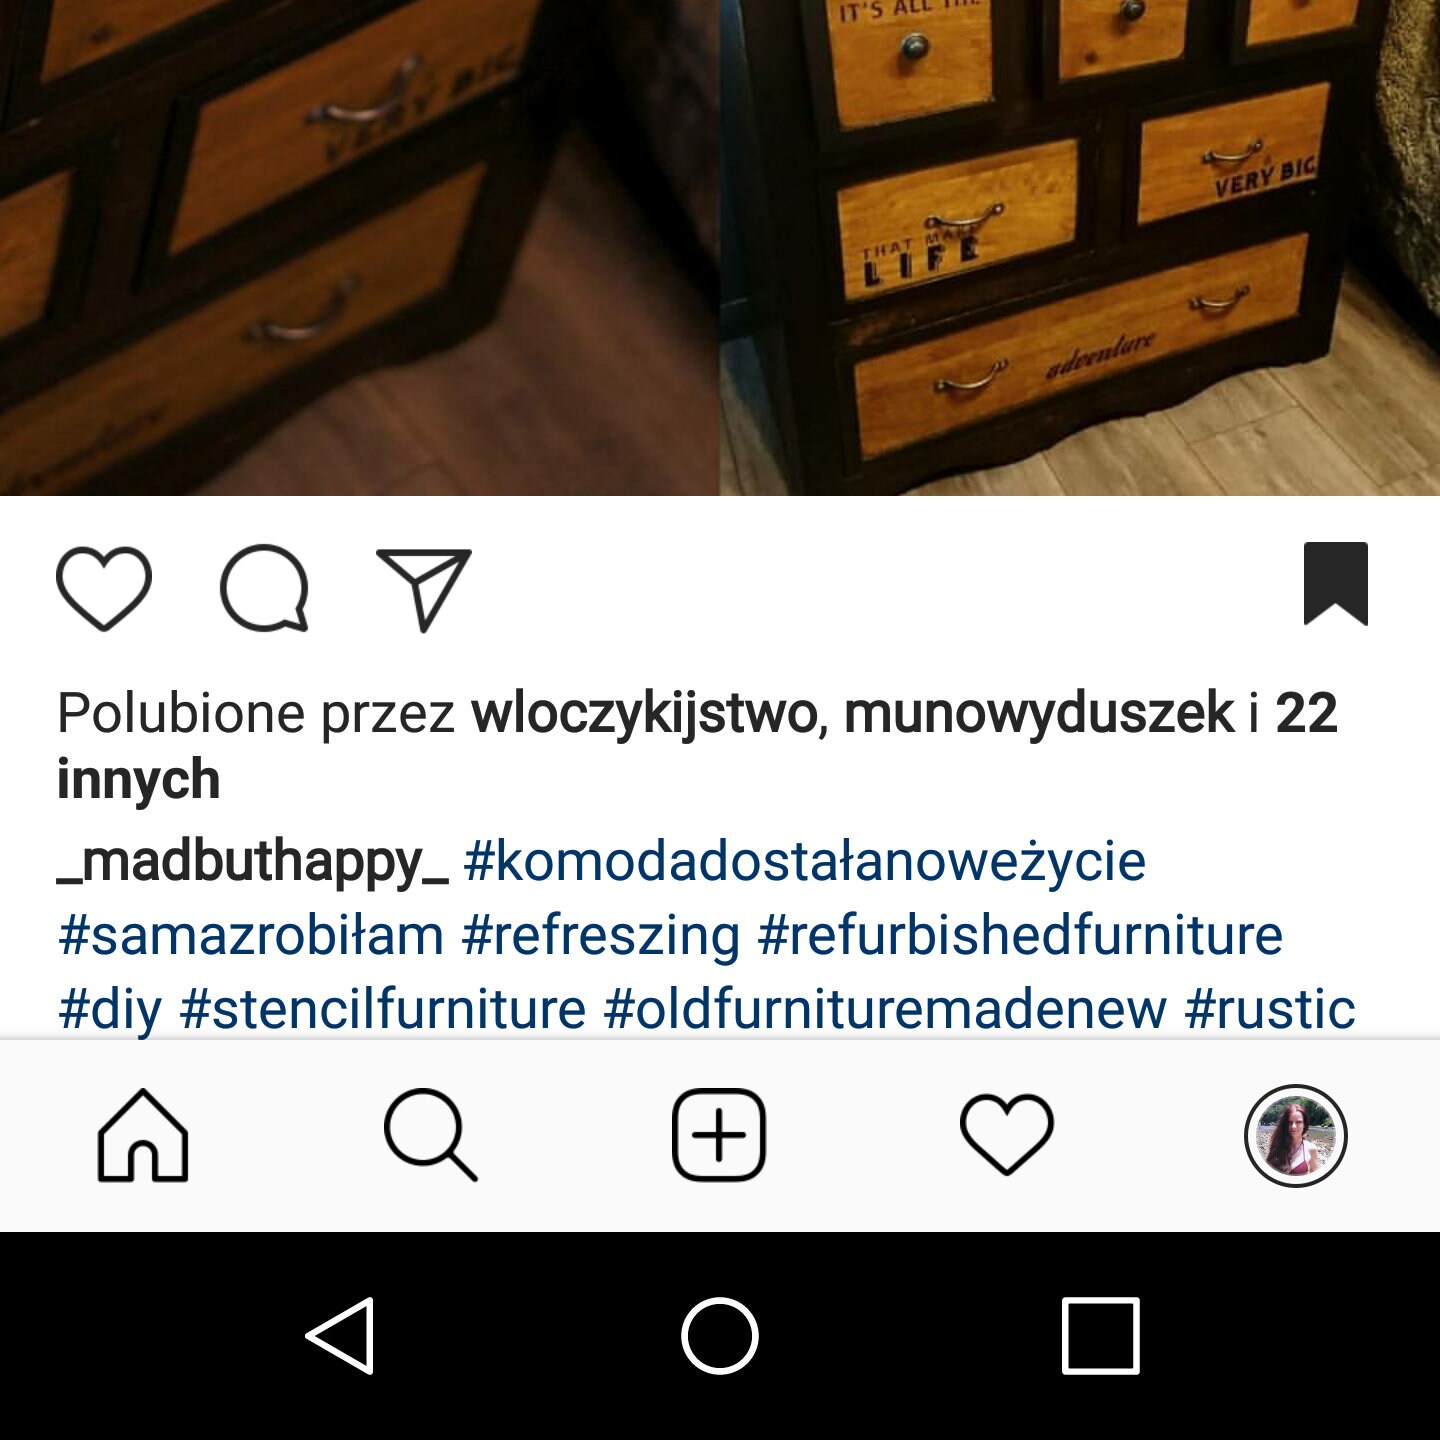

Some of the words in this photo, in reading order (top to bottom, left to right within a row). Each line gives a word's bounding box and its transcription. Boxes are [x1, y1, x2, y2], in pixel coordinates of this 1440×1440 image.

[839, 0, 884, 23] IT'S
[1216, 165, 1275, 198] VERY
[863, 237, 913, 260] THAT
[863, 237, 980, 287] LIFE
[1046, 333, 1157, 380] adventure
[59, 689, 305, 734] Polubione
[323, 701, 455, 743] przez
[470, 687, 828, 744] wloczykijstwo,
[846, 687, 1237, 744] munowyduszek
[1250, 690, 1258, 733] i
[1276, 690, 1338, 733] 22
[58, 755, 220, 811] innych
[55, 835, 450, 893] _madbuthappy_
[463, 837, 1146, 893] #komodadostałanoweżycie
[58, 911, 443, 956] #samazrobiłam
[461, 910, 739, 967] #refreszing
[757, 910, 1283, 956] #refurbishedfurniture
[58, 985, 163, 1040] #diy
[179, 984, 586, 1030] #stencilfurniture
[603, 984, 1168, 1030] #oldfurnituremadenew
[1184, 986, 1356, 1030] #rustic
